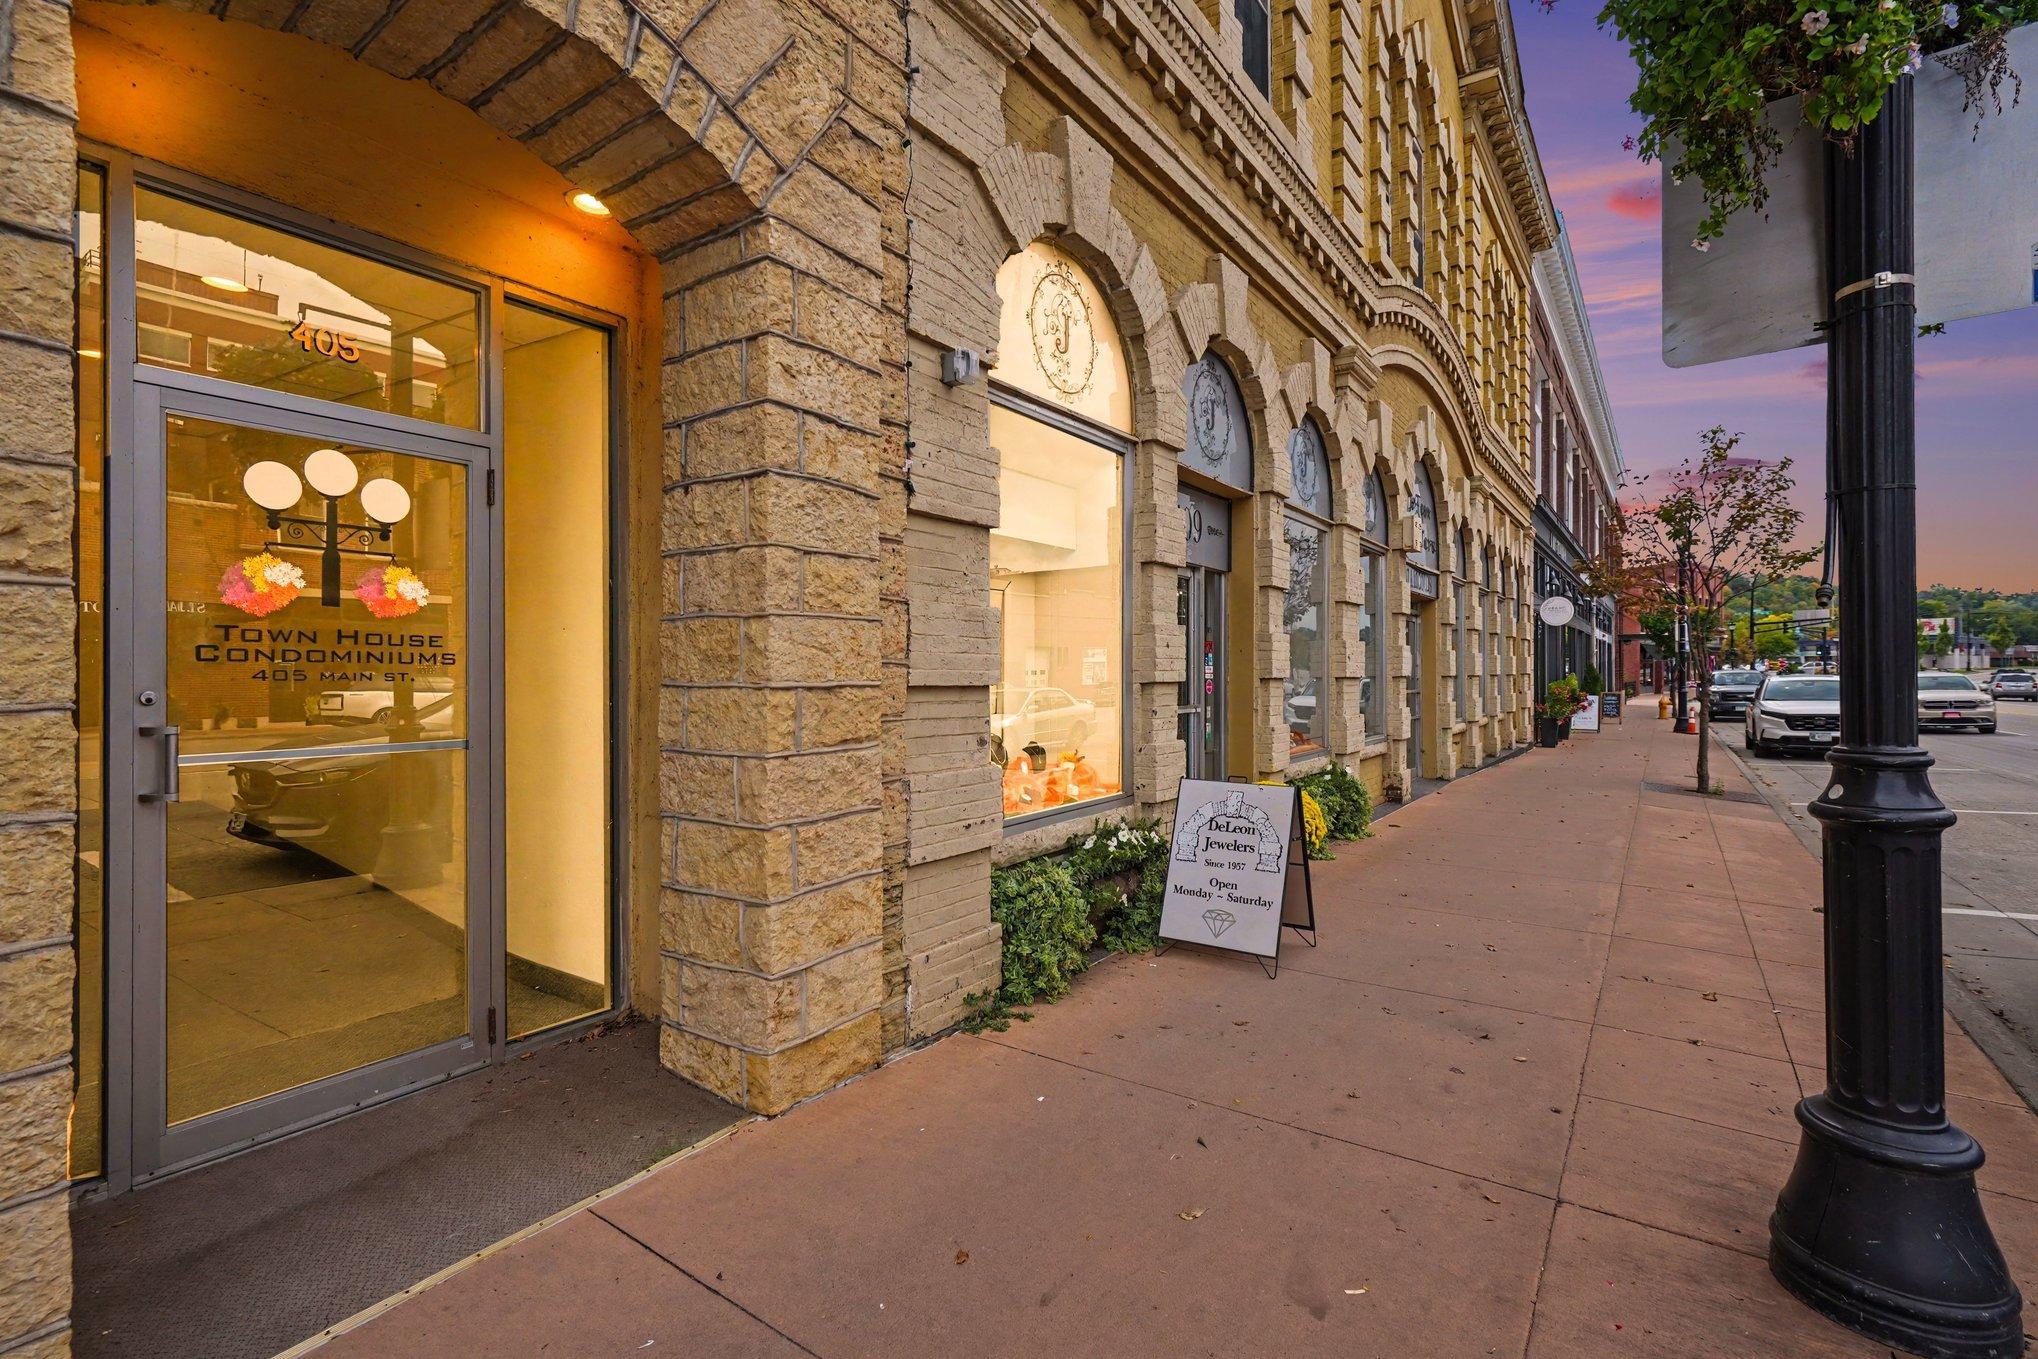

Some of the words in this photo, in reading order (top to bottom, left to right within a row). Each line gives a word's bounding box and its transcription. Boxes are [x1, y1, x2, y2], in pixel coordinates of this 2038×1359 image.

[289, 321, 360, 363] 405
[214, 625, 317, 643] TOWN
[337, 629, 443, 648] HOUSE
[194, 645, 456, 665] CONDOMINIUMS
[252, 669, 307, 682] 405
[320, 671, 375, 682] MAIN
[384, 672, 415, 682] ST.
[1208, 818, 1256, 835] DeLeon
[1202, 836, 1256, 853] Jewelers
[1204, 859, 1225, 869] Since
[1228, 861, 1246, 871] 1957
[1209, 877, 1238, 890] Open
[1173, 884, 1214, 902] Monday
[1227, 892, 1274, 911] Saturday
